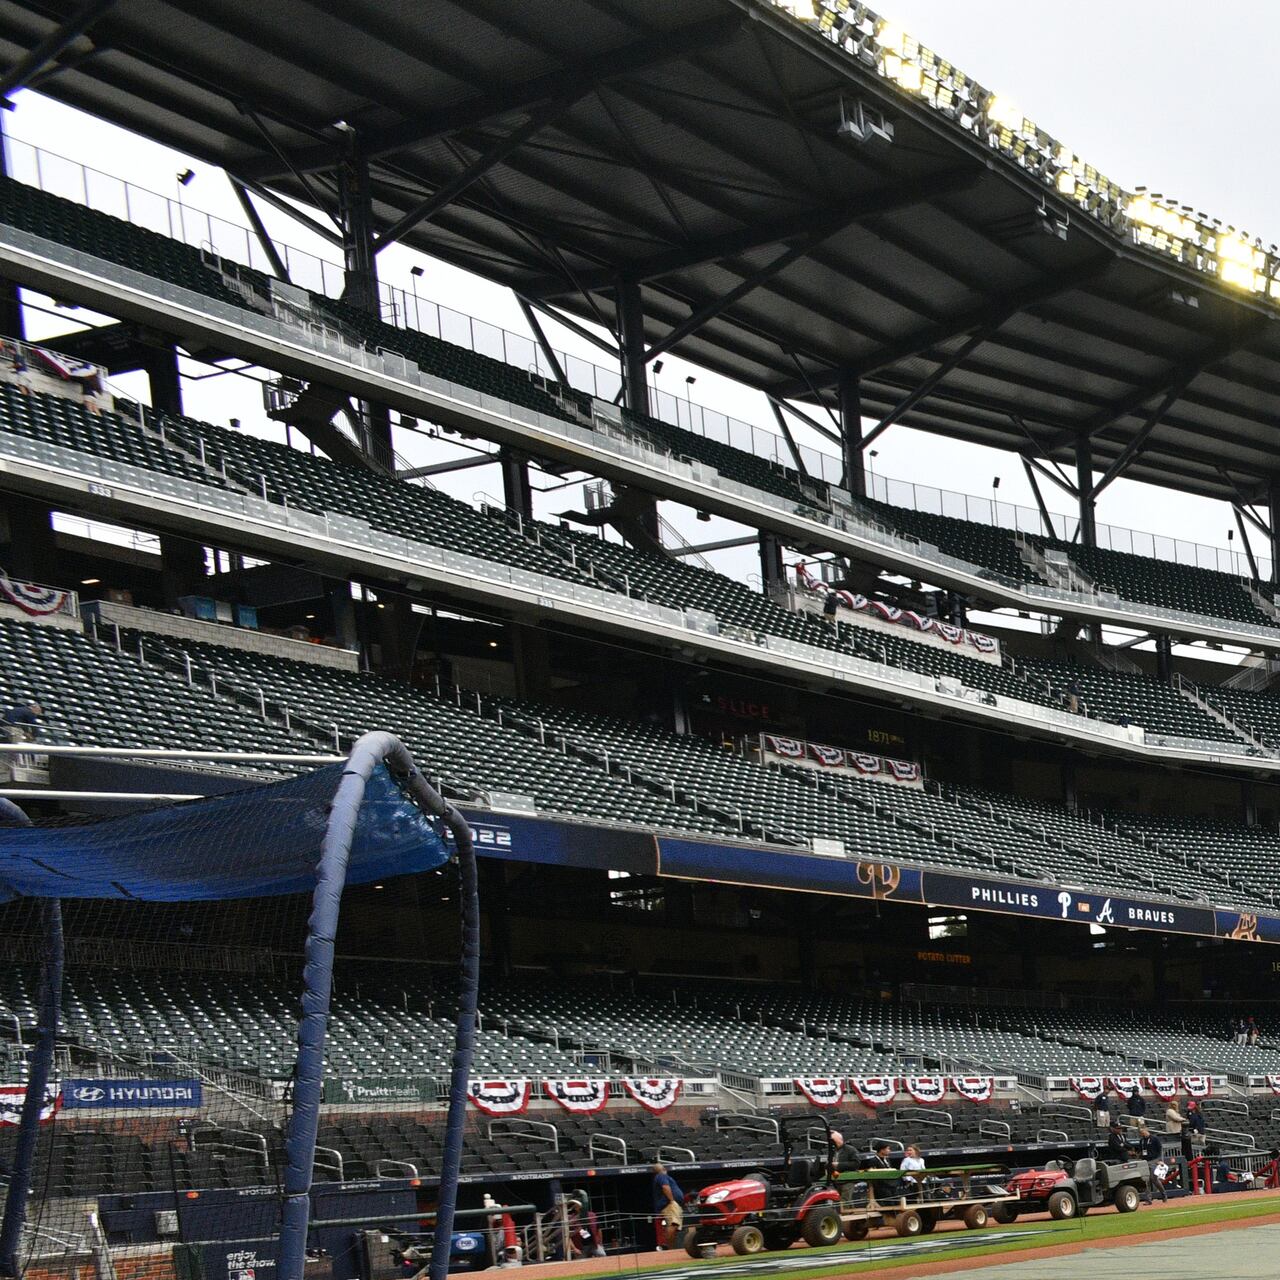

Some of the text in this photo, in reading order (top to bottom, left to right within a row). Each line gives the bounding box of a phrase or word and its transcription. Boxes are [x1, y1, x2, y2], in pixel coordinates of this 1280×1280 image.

[972, 887, 1038, 907] PHILLIES
[1128, 907, 1175, 924] BRAVES
[111, 1087, 192, 1100] HYUNDAI
[357, 1086, 420, 1097] PruittHealth
[226, 1250, 257, 1261] enjoy
[227, 1260, 246, 1270] the
